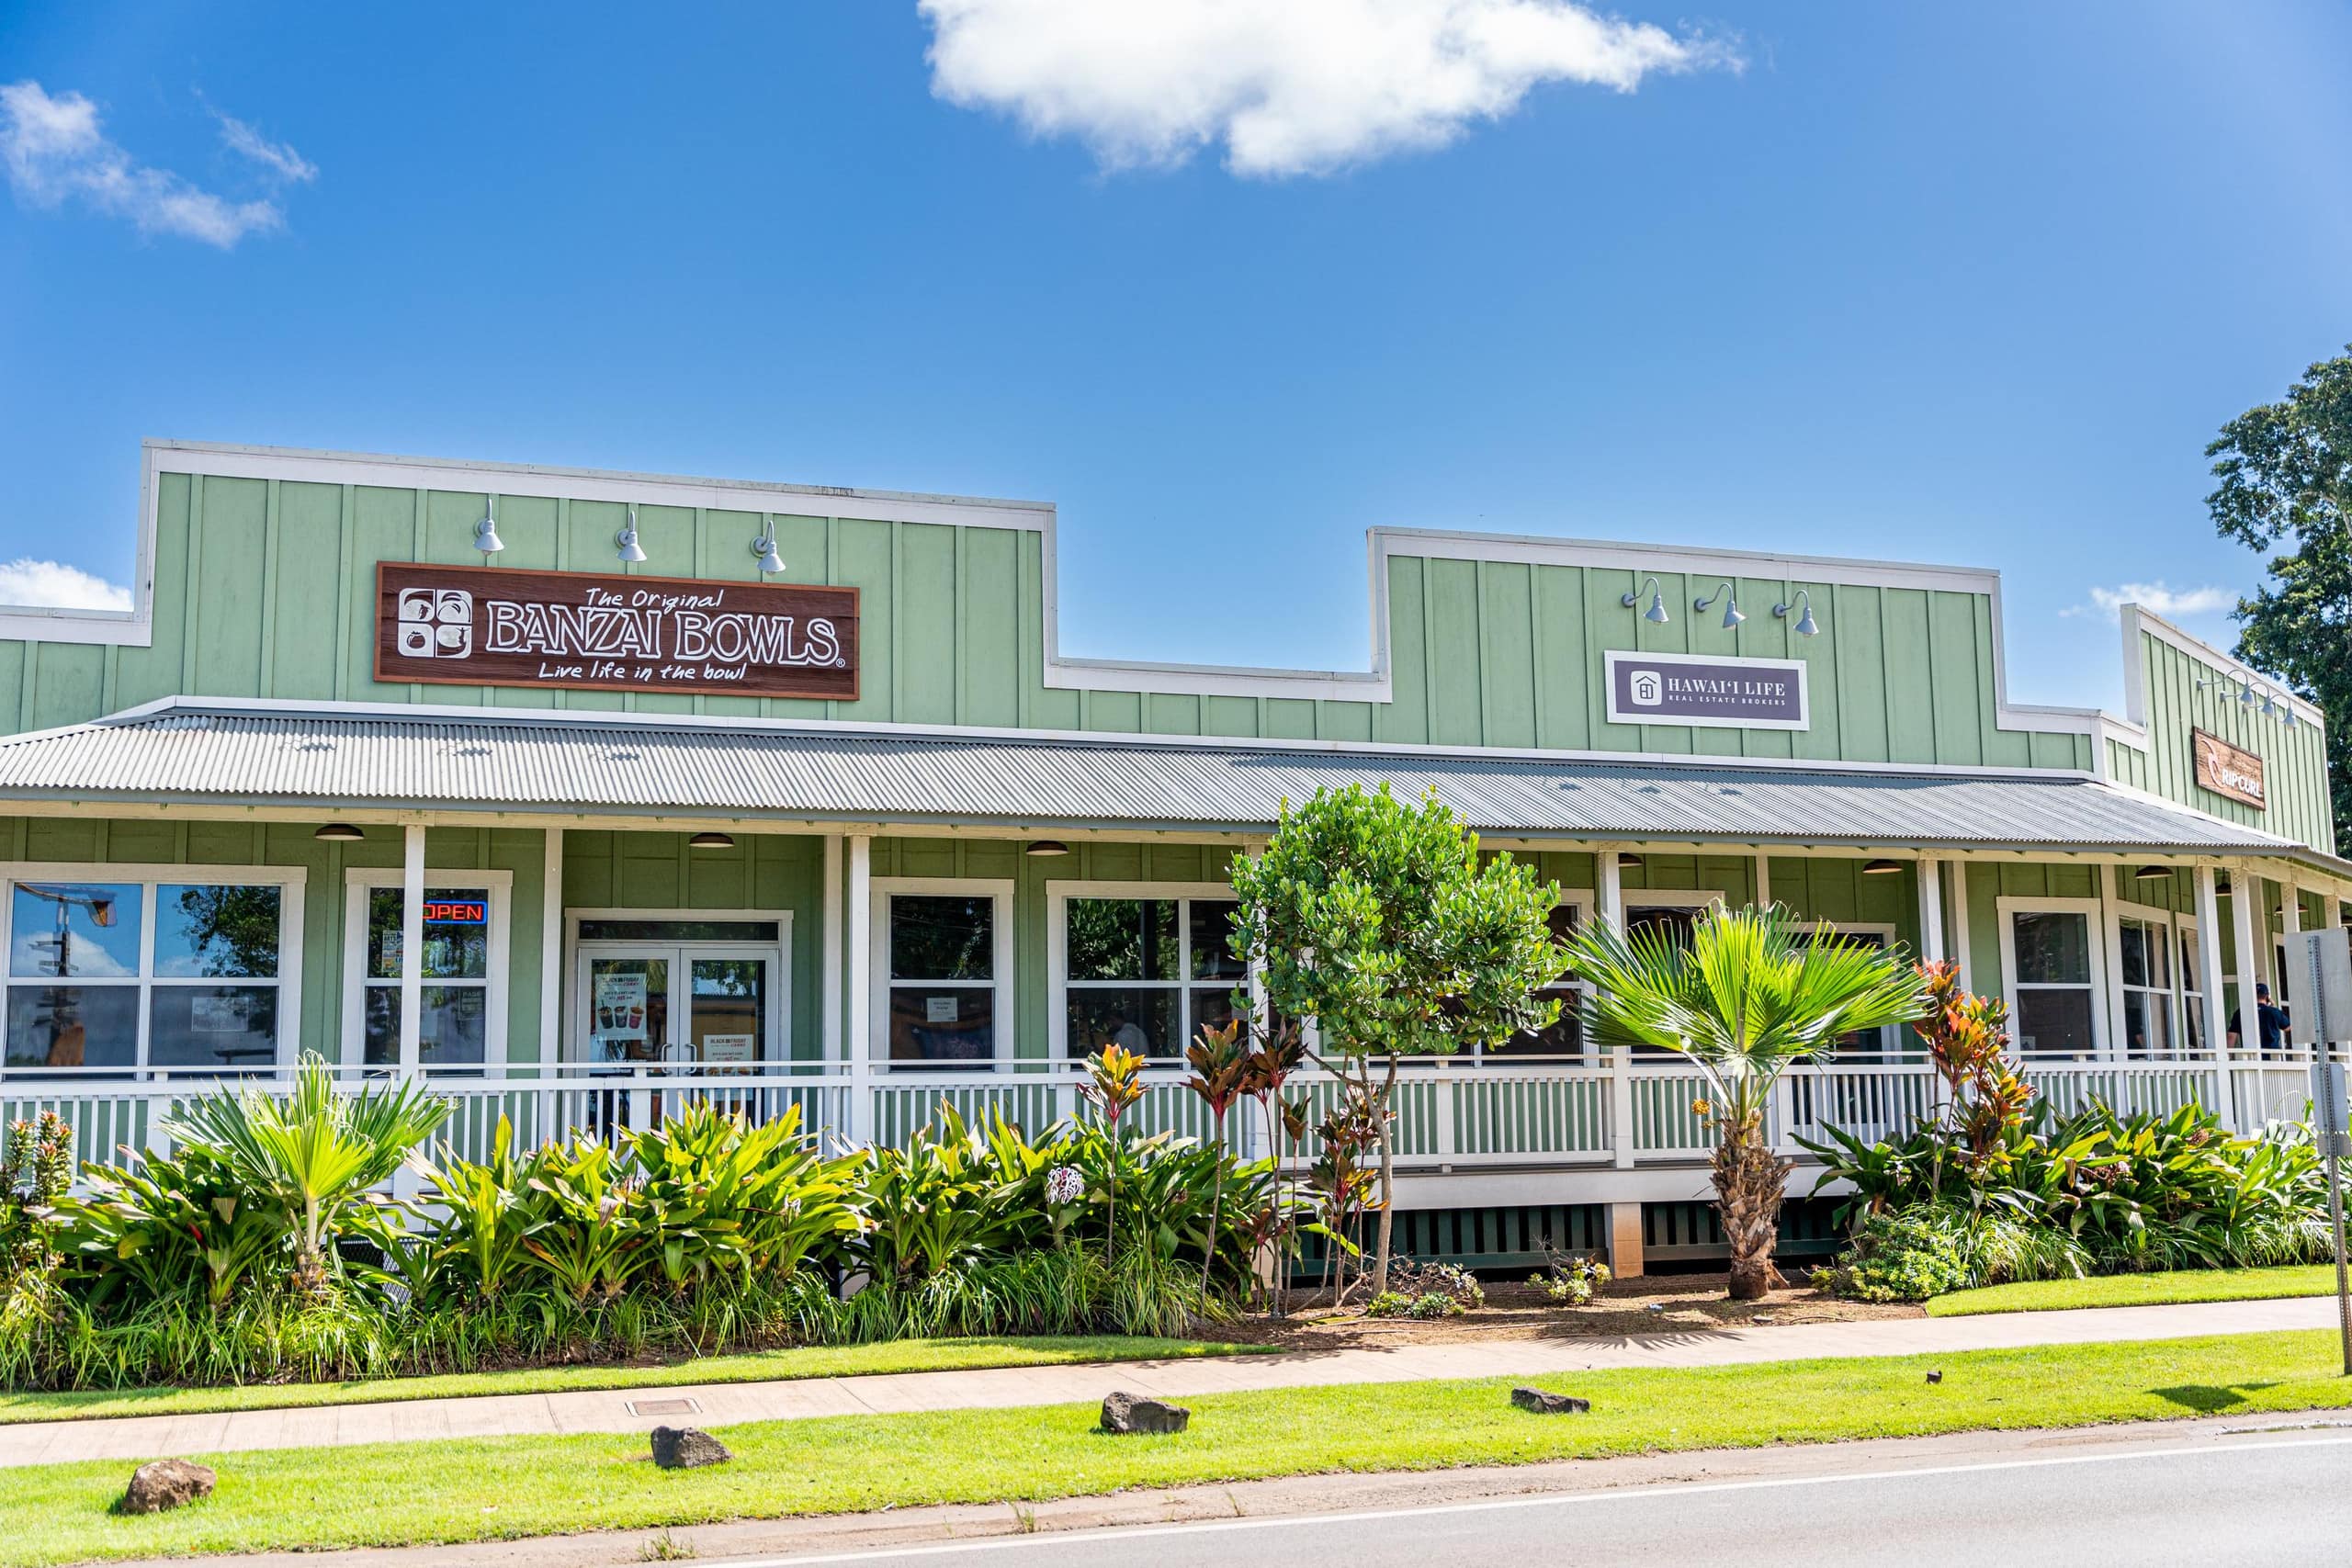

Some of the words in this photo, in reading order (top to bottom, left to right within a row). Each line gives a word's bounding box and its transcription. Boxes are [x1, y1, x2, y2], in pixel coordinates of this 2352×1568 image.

[586, 587, 623, 606] The
[632, 589, 724, 615] Original
[486, 601, 662, 659] BANZAI
[673, 610, 840, 666] BOWLS
[538, 662, 582, 679] Live
[590, 660, 626, 679] life
[633, 665, 652, 682] in
[660, 664, 695, 680] the
[703, 662, 747, 681] bowl
[1745, 682, 1785, 696] LIFE
[1742, 698, 1785, 706] BROKERS
[2222, 769, 2237, 786] RIP
[2238, 776, 2263, 797] CURL
[422, 904, 482, 920] OPEN
